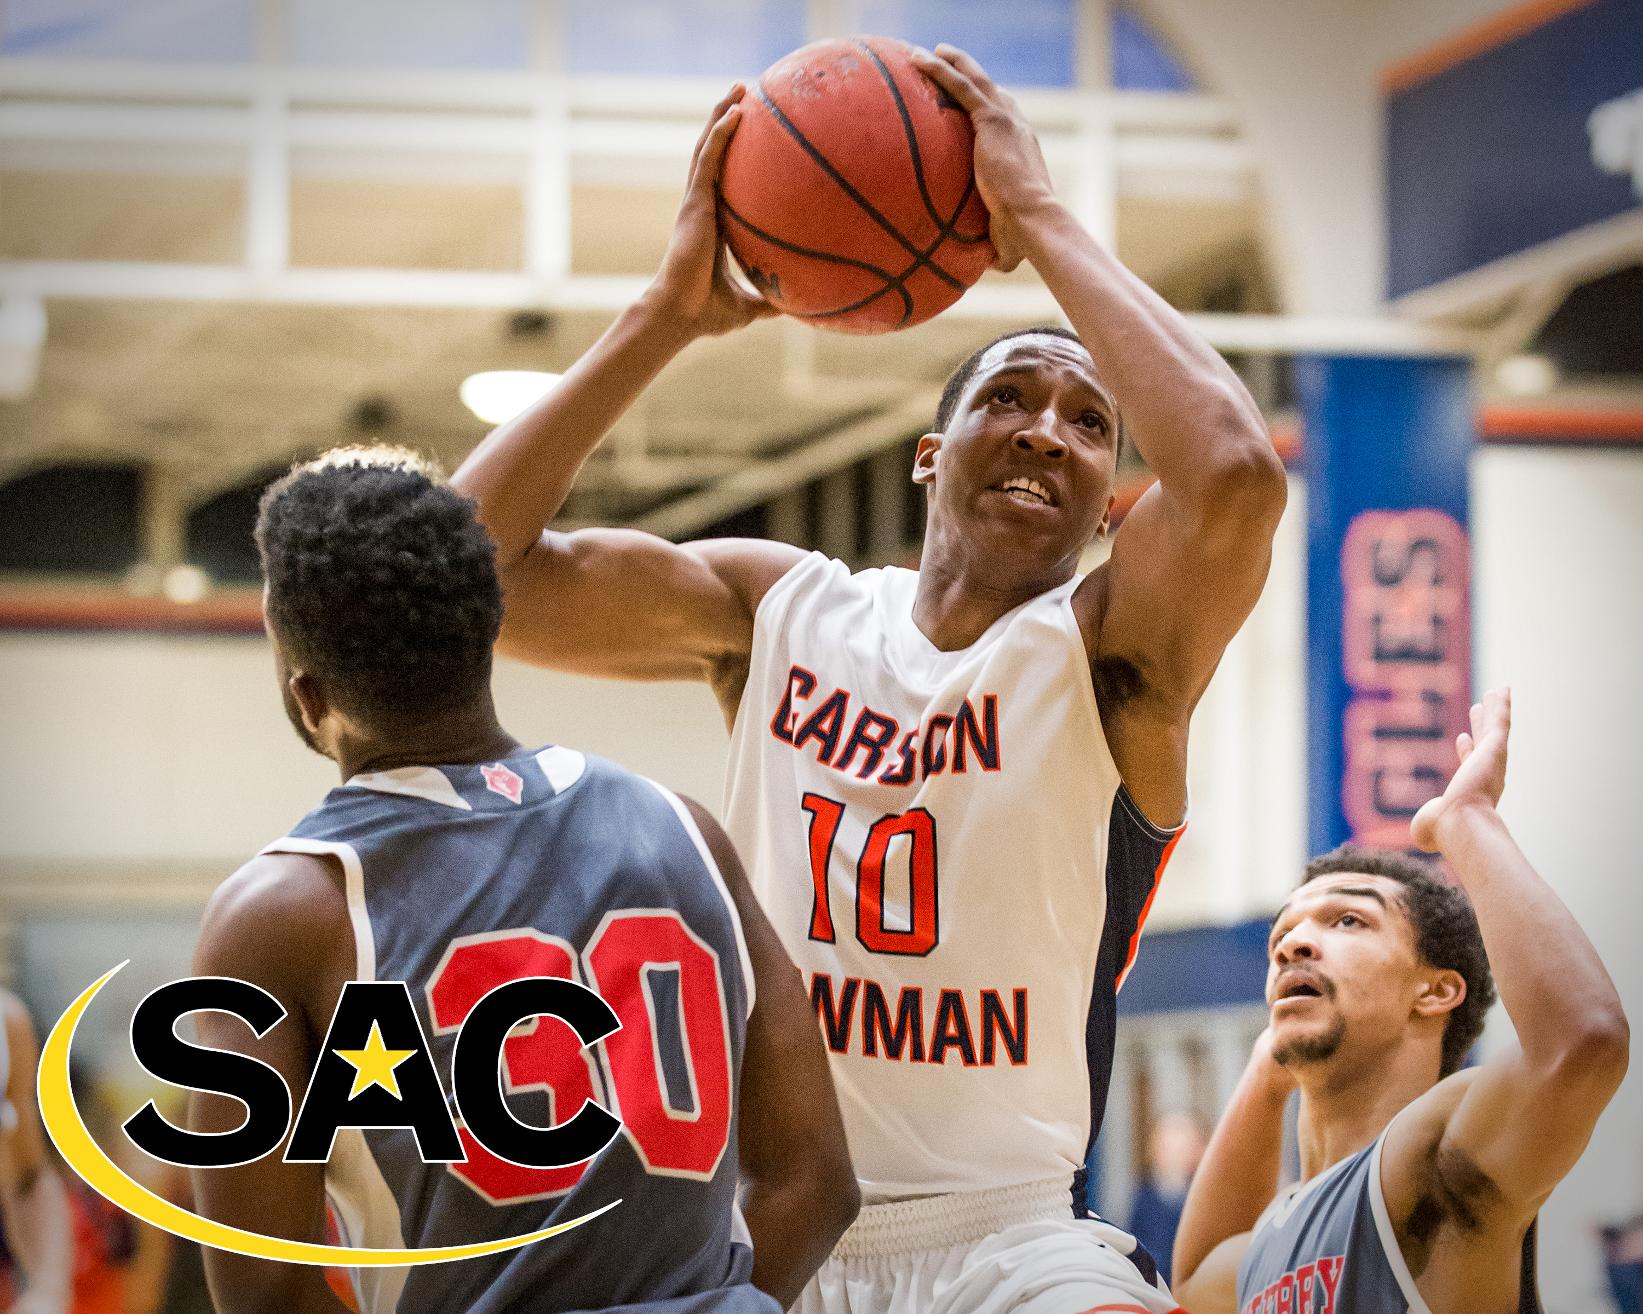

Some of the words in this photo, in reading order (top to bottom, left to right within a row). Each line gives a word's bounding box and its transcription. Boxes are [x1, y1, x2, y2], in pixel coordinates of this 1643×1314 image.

[770, 664, 1002, 786] CARSON
[801, 792, 939, 957] 10
[425, 907, 733, 1207] 30
